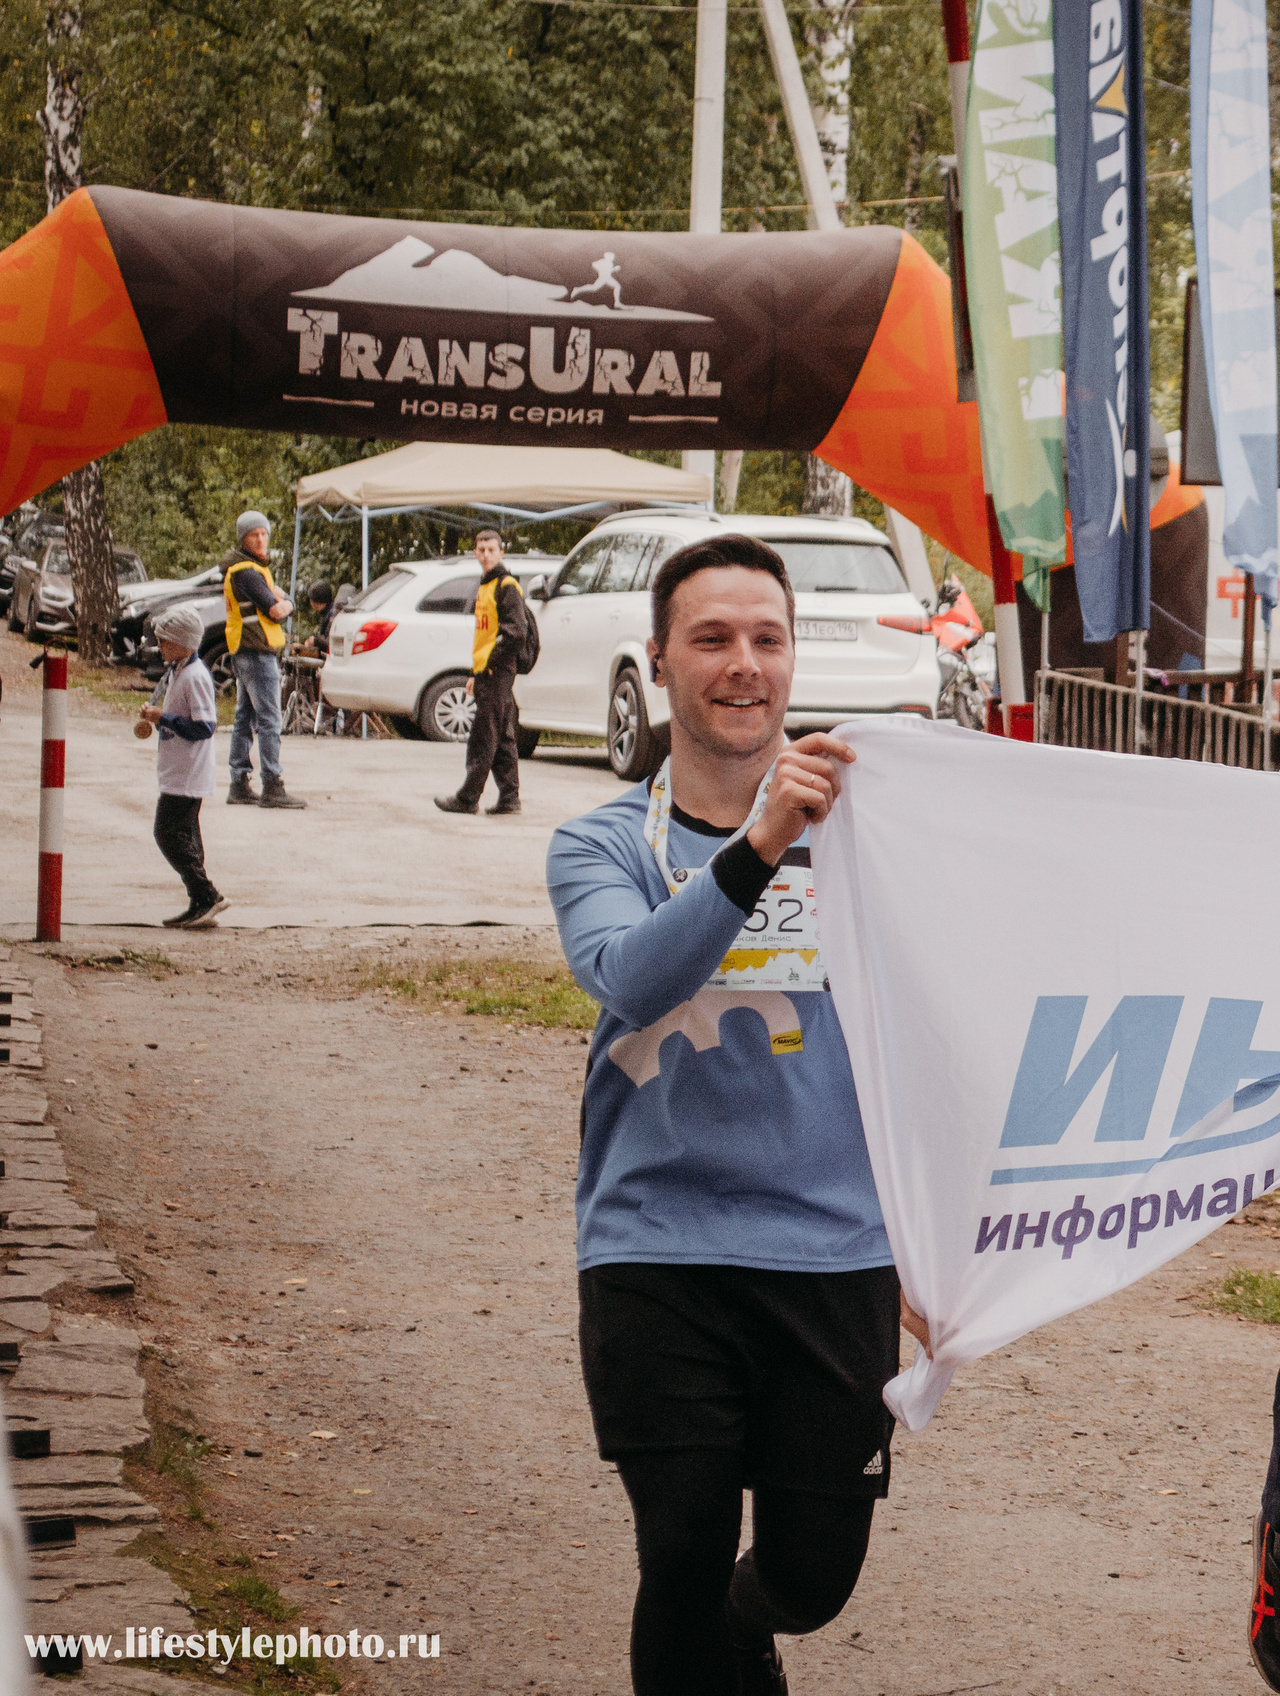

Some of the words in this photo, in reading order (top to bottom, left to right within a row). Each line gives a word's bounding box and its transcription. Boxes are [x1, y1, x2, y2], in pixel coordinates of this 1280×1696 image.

[401, 399, 498, 421] новая
[509, 404, 605, 427] серия
[761, 934, 792, 942] Денис
